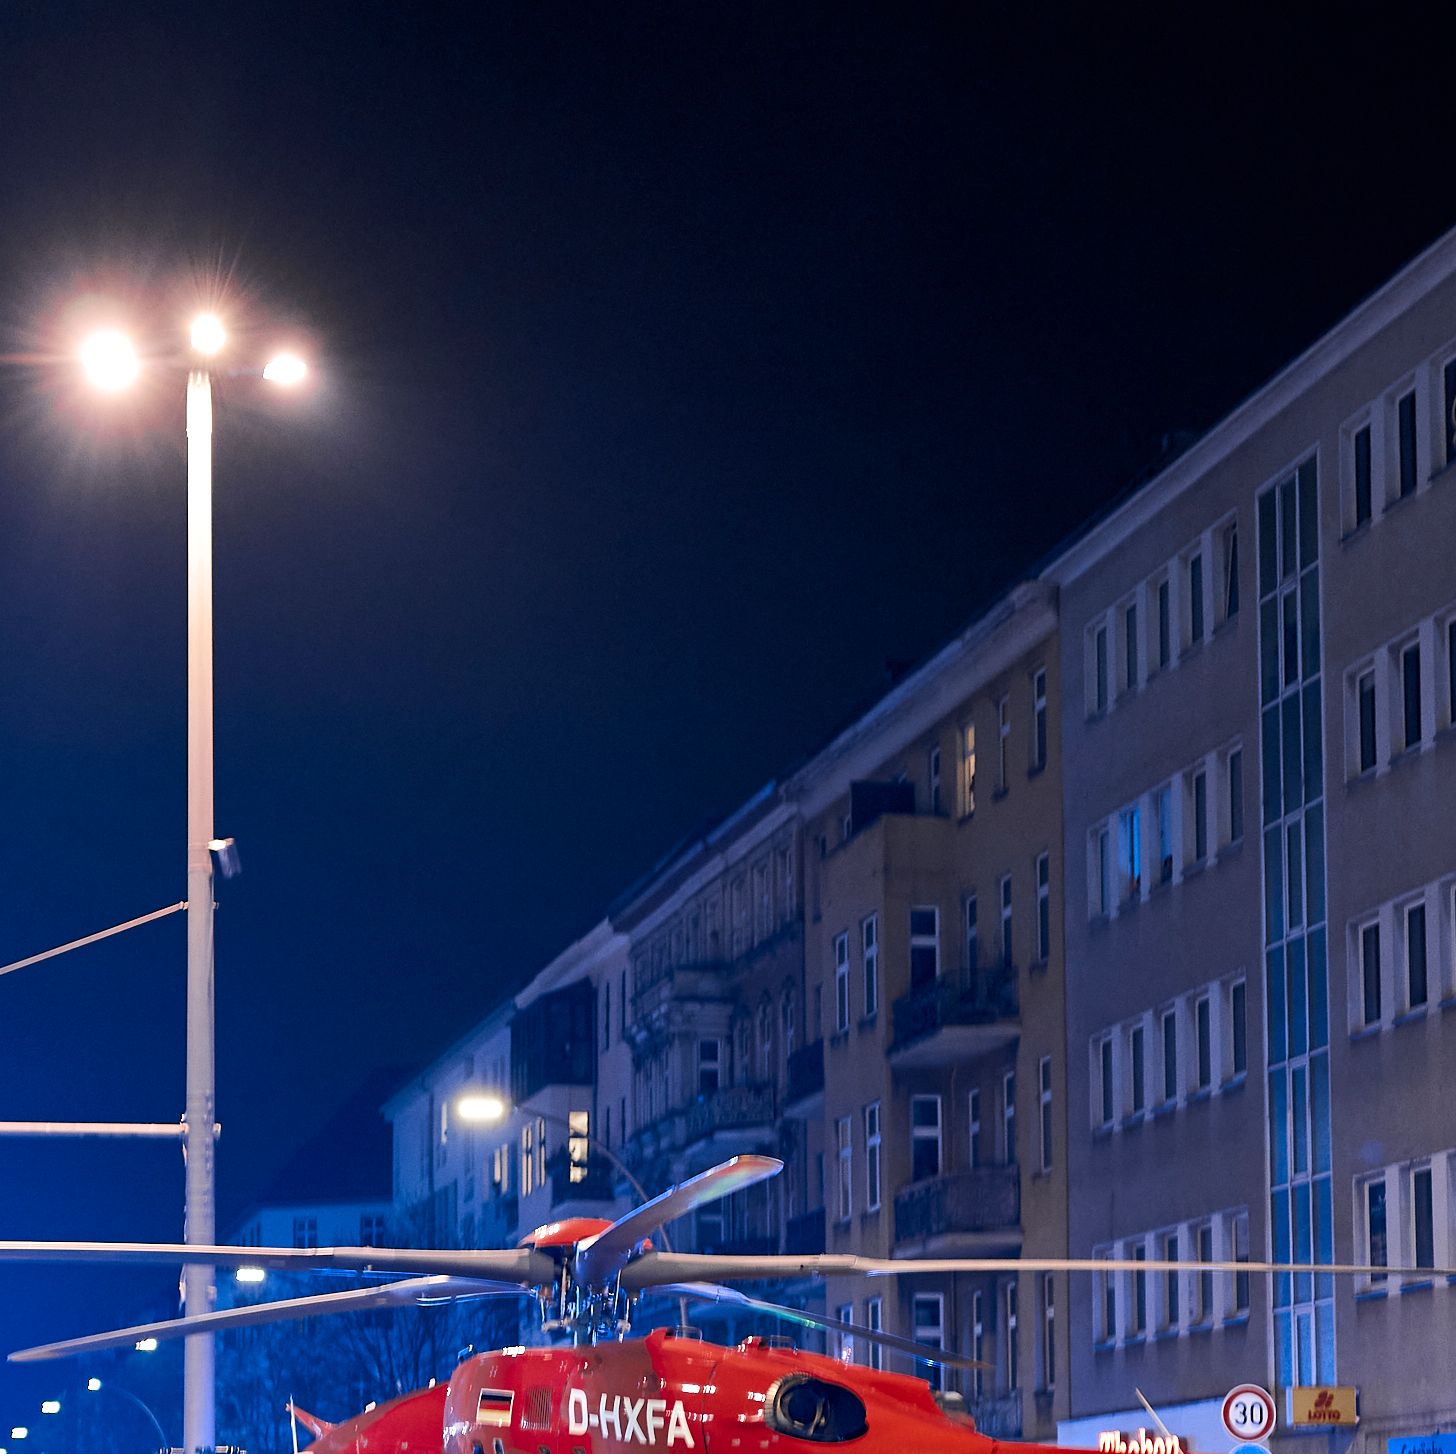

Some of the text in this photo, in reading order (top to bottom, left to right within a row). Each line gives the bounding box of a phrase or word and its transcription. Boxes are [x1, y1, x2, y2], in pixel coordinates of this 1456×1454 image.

[568, 1388, 695, 1448] D-HXFA
[1233, 1401, 1264, 1425] 30
[1307, 1409, 1342, 1421] LOTTO
